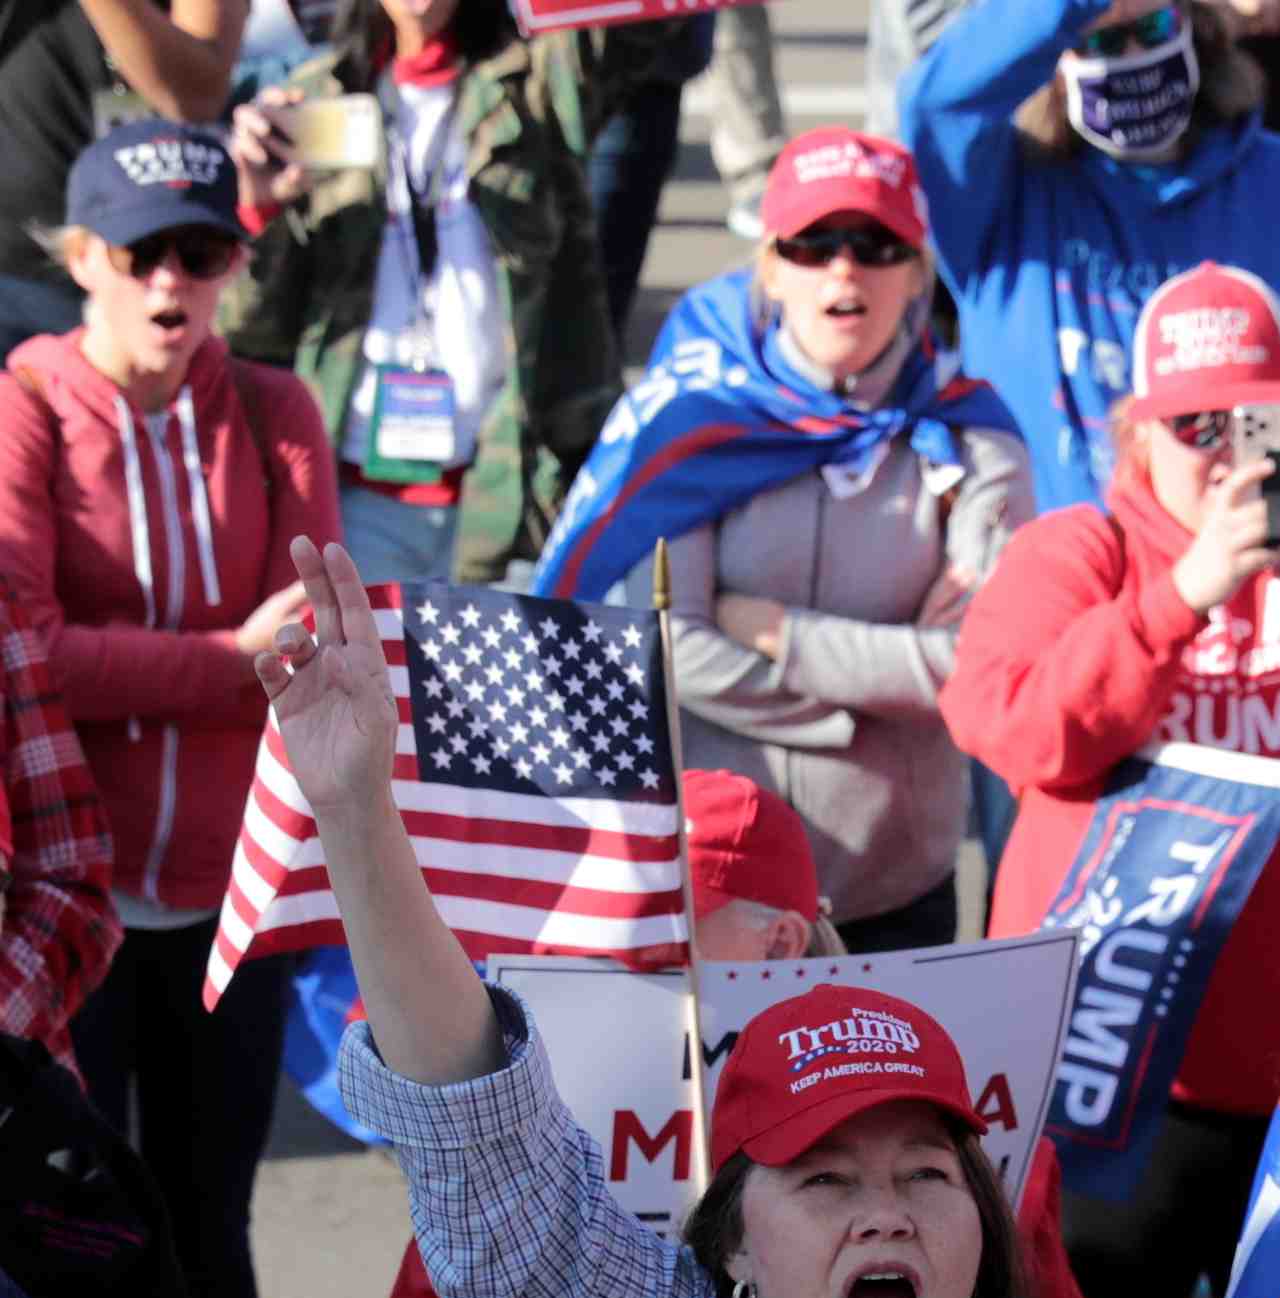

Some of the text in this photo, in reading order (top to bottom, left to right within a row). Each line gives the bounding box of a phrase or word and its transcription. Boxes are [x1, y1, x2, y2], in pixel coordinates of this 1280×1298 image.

[1055, 827, 1234, 1128] TRUMP
[851, 1007, 913, 1033] President
[778, 1017, 921, 1061] Trump
[846, 1039, 897, 1054] 2020
[790, 1071, 822, 1095] KEEP
[823, 1062, 885, 1081] AMERICA
